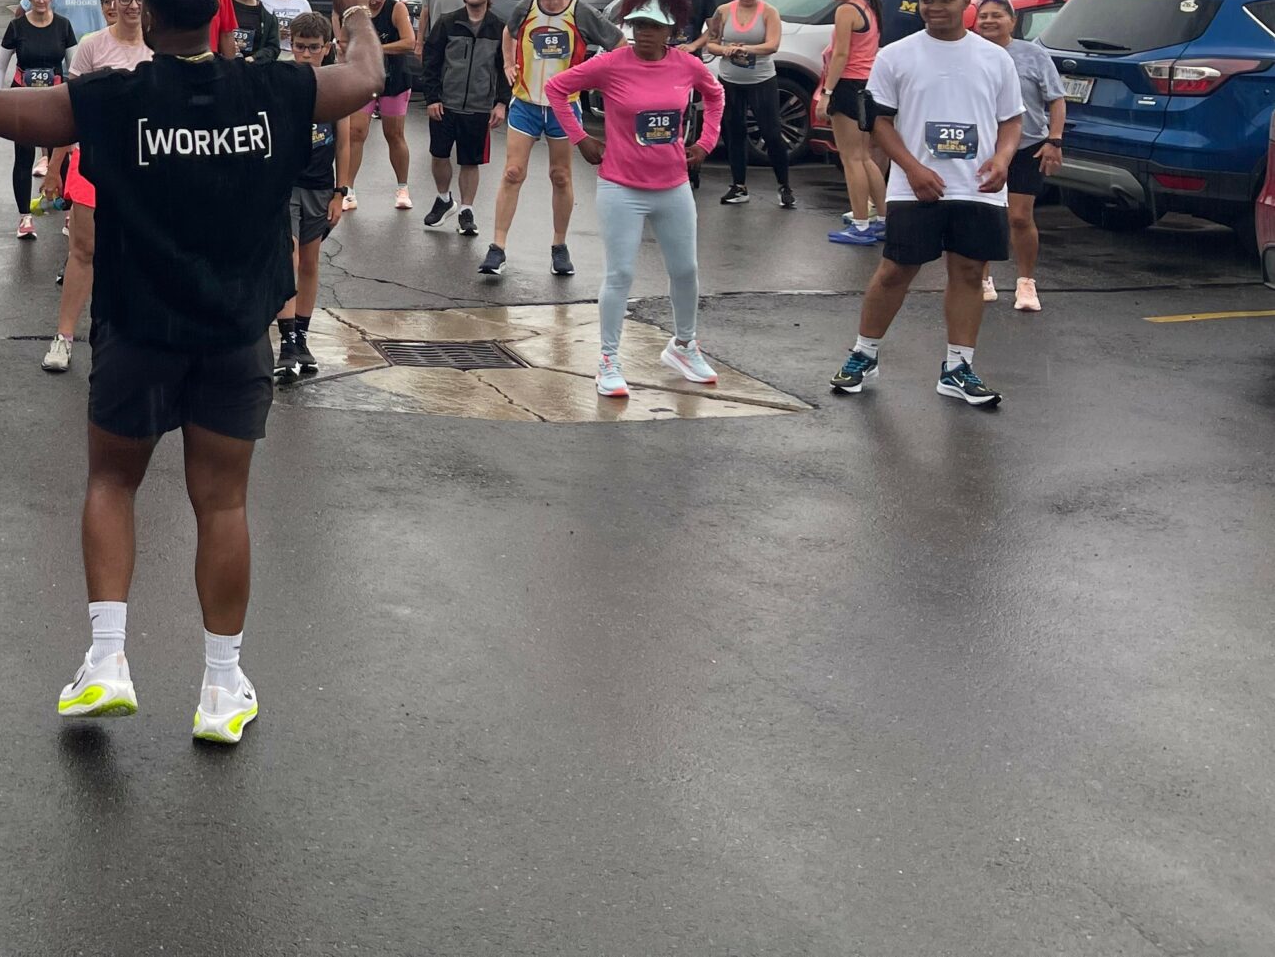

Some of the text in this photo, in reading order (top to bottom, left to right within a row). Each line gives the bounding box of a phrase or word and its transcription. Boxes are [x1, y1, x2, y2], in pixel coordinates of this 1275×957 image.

[545, 36, 559, 45] 68
[31, 72, 50, 81] 249
[648, 116, 670, 127] 218
[939, 128, 965, 140] 219
